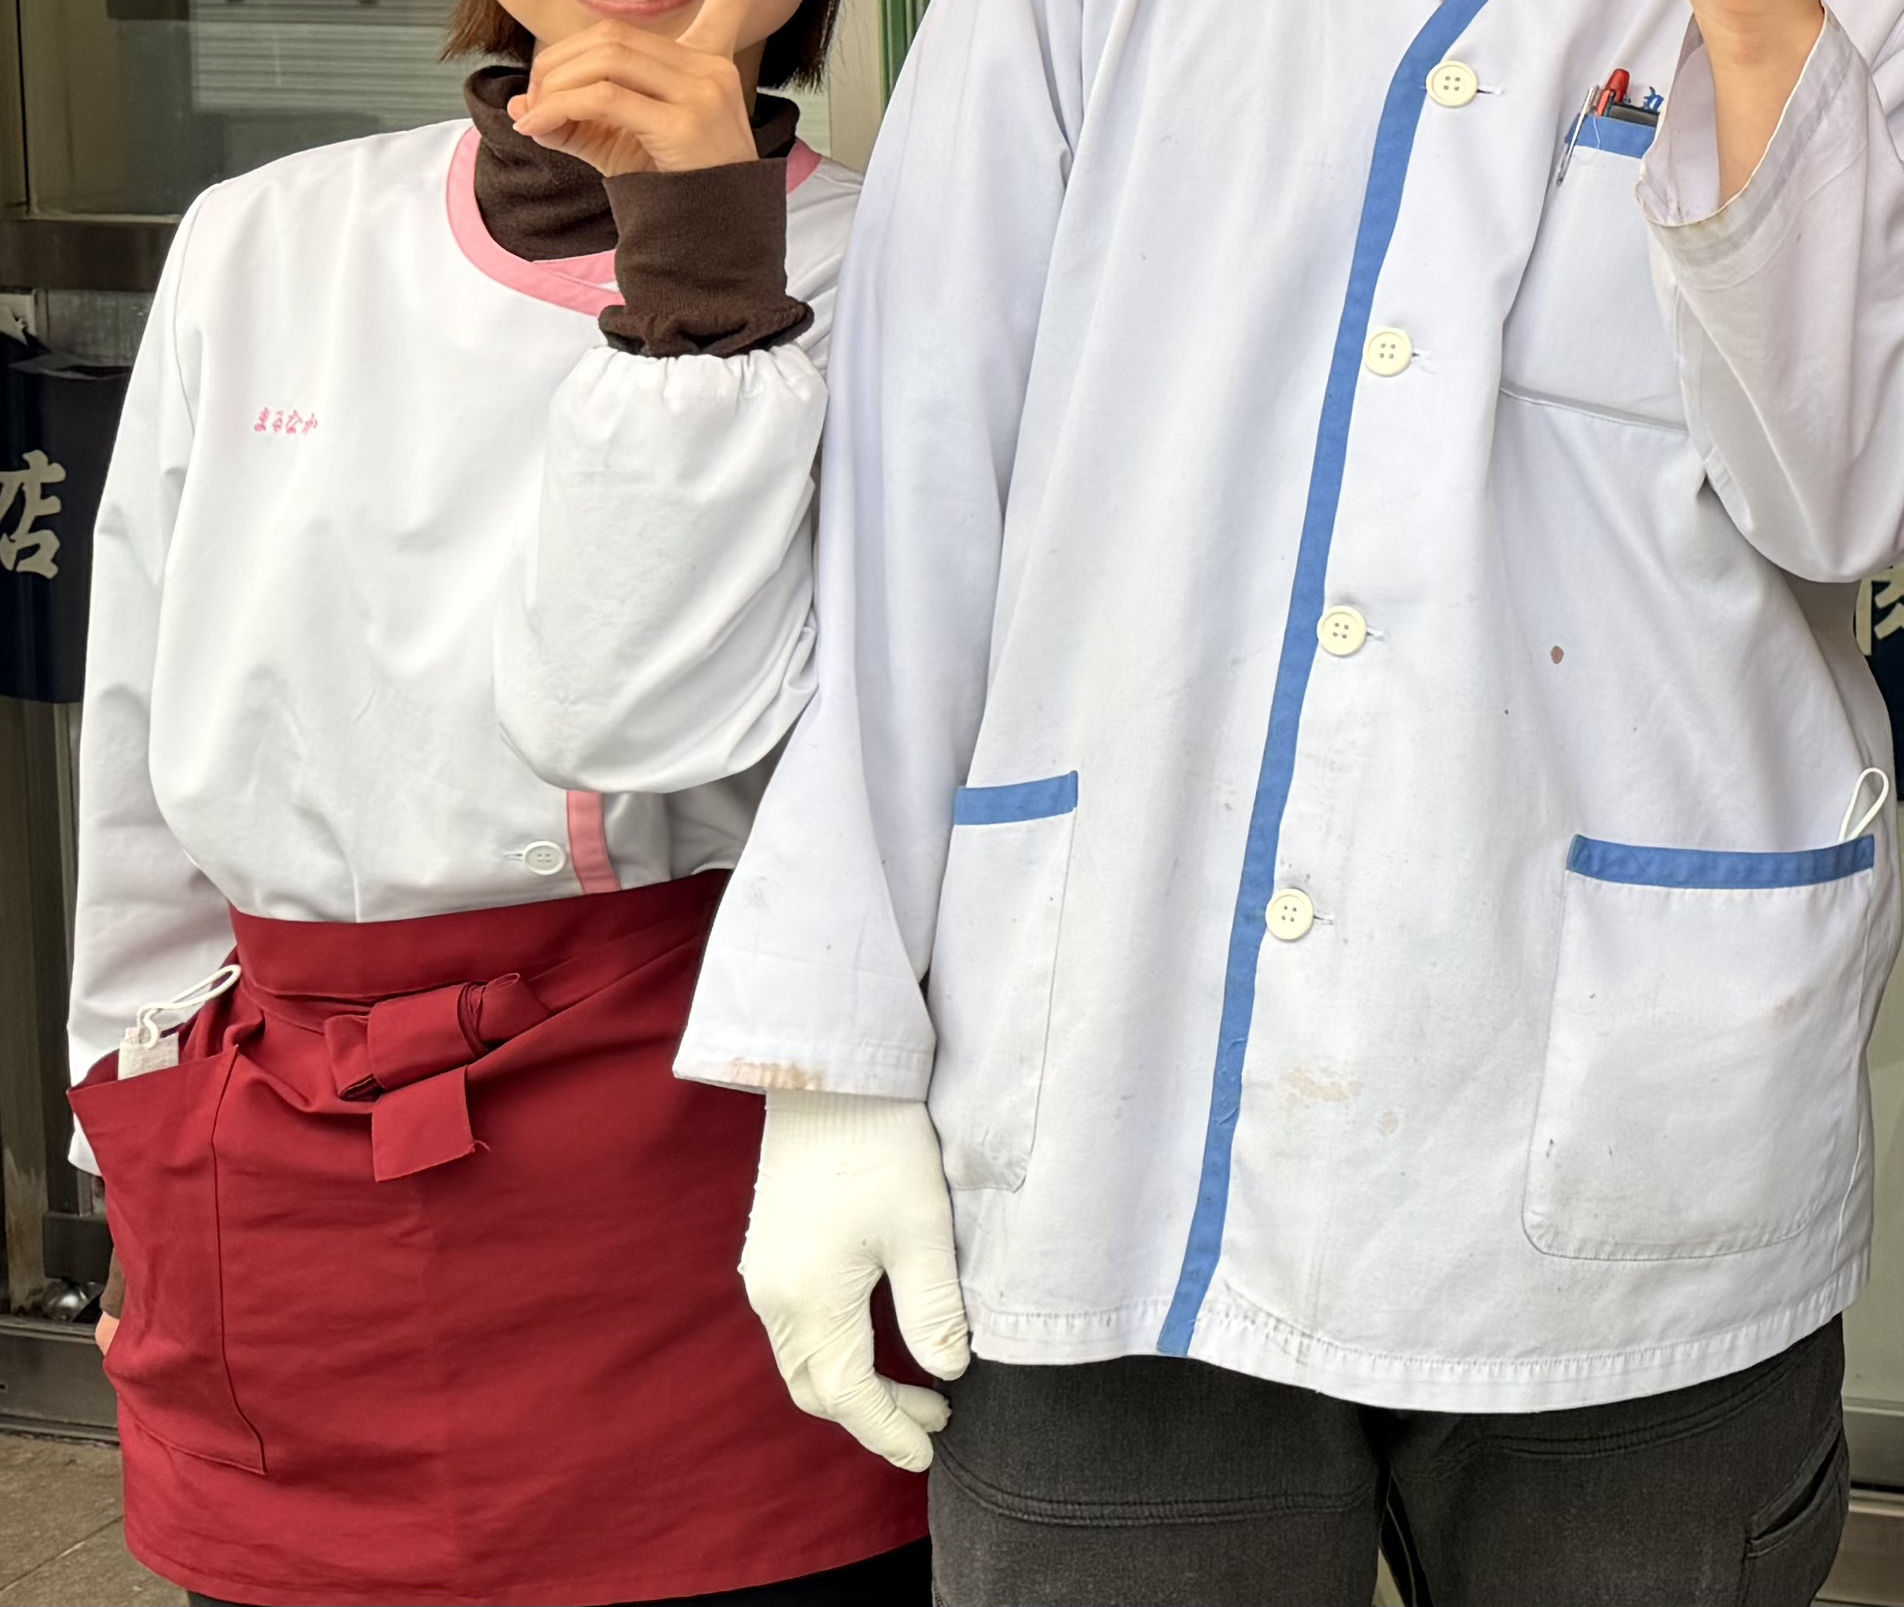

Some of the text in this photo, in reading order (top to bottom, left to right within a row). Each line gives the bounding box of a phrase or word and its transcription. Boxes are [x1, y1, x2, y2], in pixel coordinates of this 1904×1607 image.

[253, 406, 319, 436] まるなか
[0, 449, 67, 580] 店
